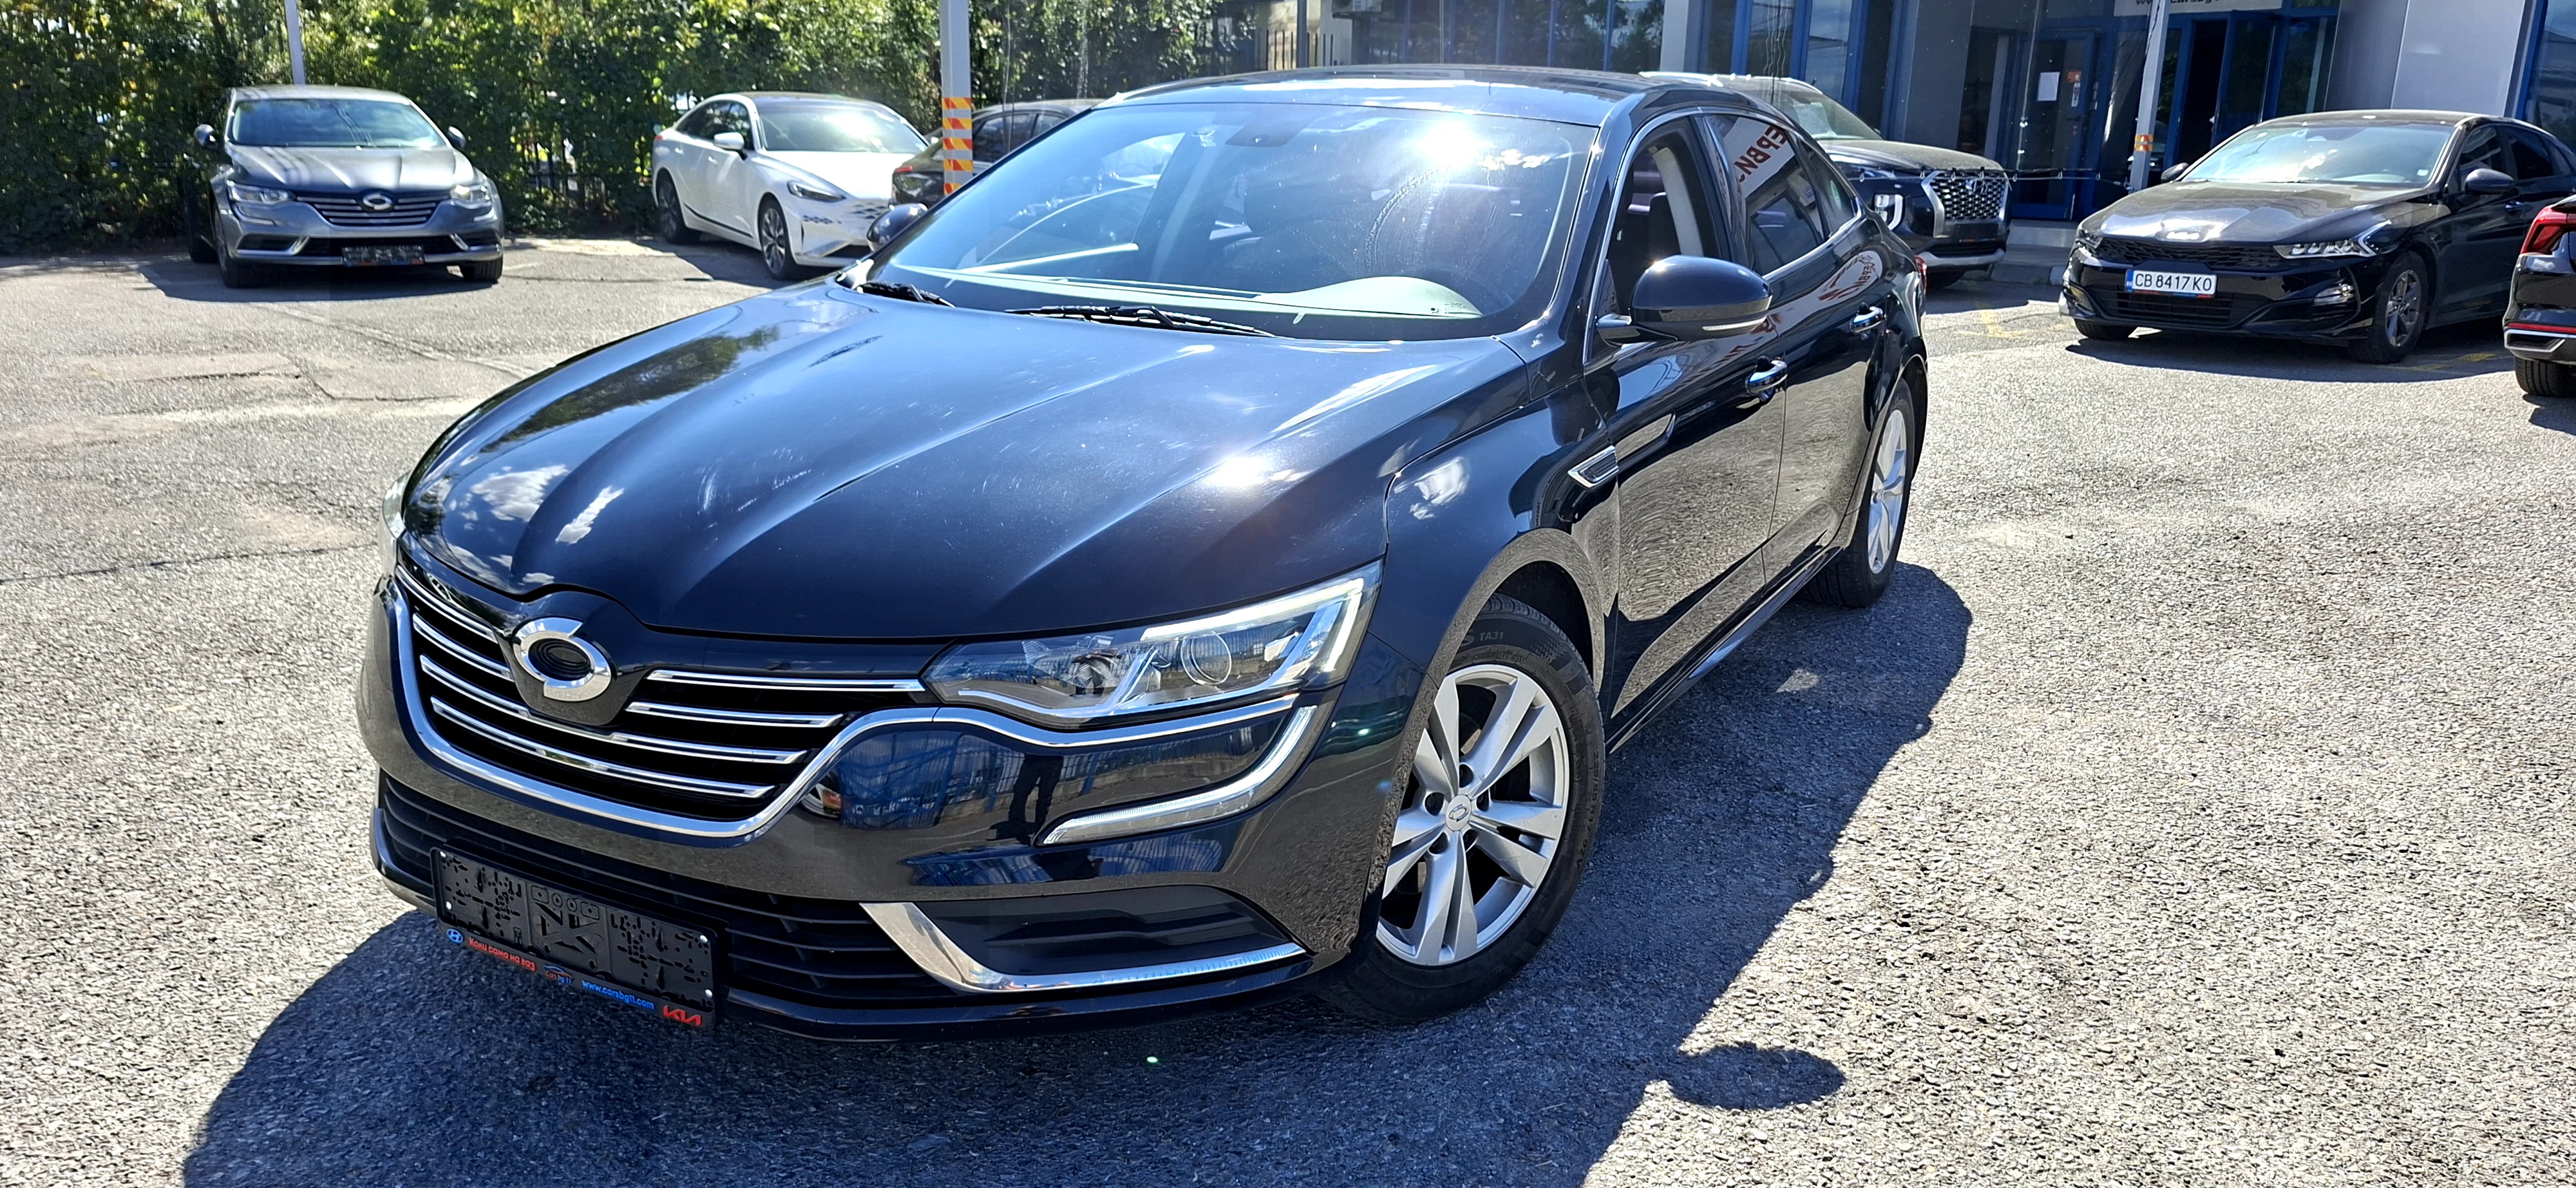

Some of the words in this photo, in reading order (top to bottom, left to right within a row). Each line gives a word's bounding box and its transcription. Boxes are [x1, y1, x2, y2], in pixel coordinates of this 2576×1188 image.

[2135, 273, 2152, 287] CB
[2155, 274, 2190, 290] 8417
[2192, 276, 2212, 291] KO
[1479, 631, 1504, 641] TA31
[488, 946, 509, 959] само
[510, 954, 520, 964] на
[582, 981, 654, 1010] www.carsbg11.com
